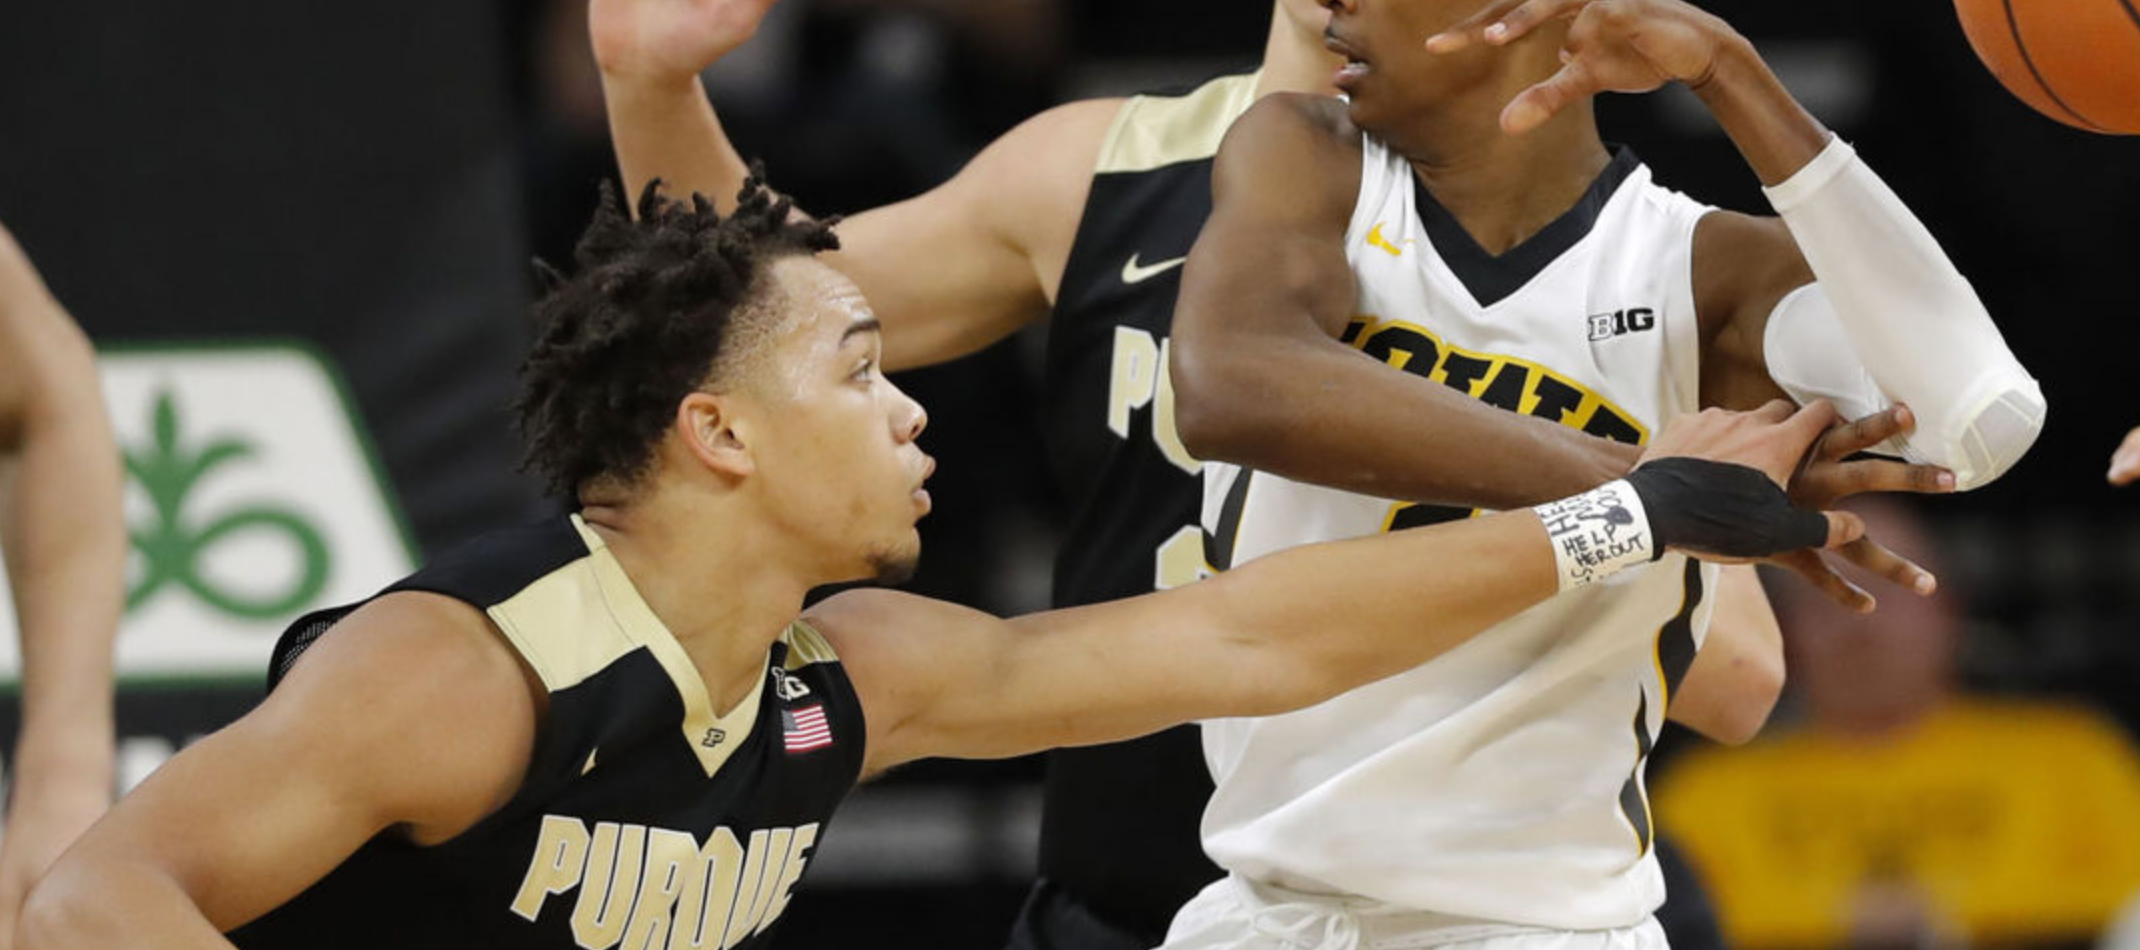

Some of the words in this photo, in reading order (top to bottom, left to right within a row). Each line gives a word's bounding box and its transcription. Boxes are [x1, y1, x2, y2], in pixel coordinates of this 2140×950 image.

[1562, 522, 1617, 557] HELP
[701, 727, 726, 748] P
[509, 814, 820, 950] PURDUE
